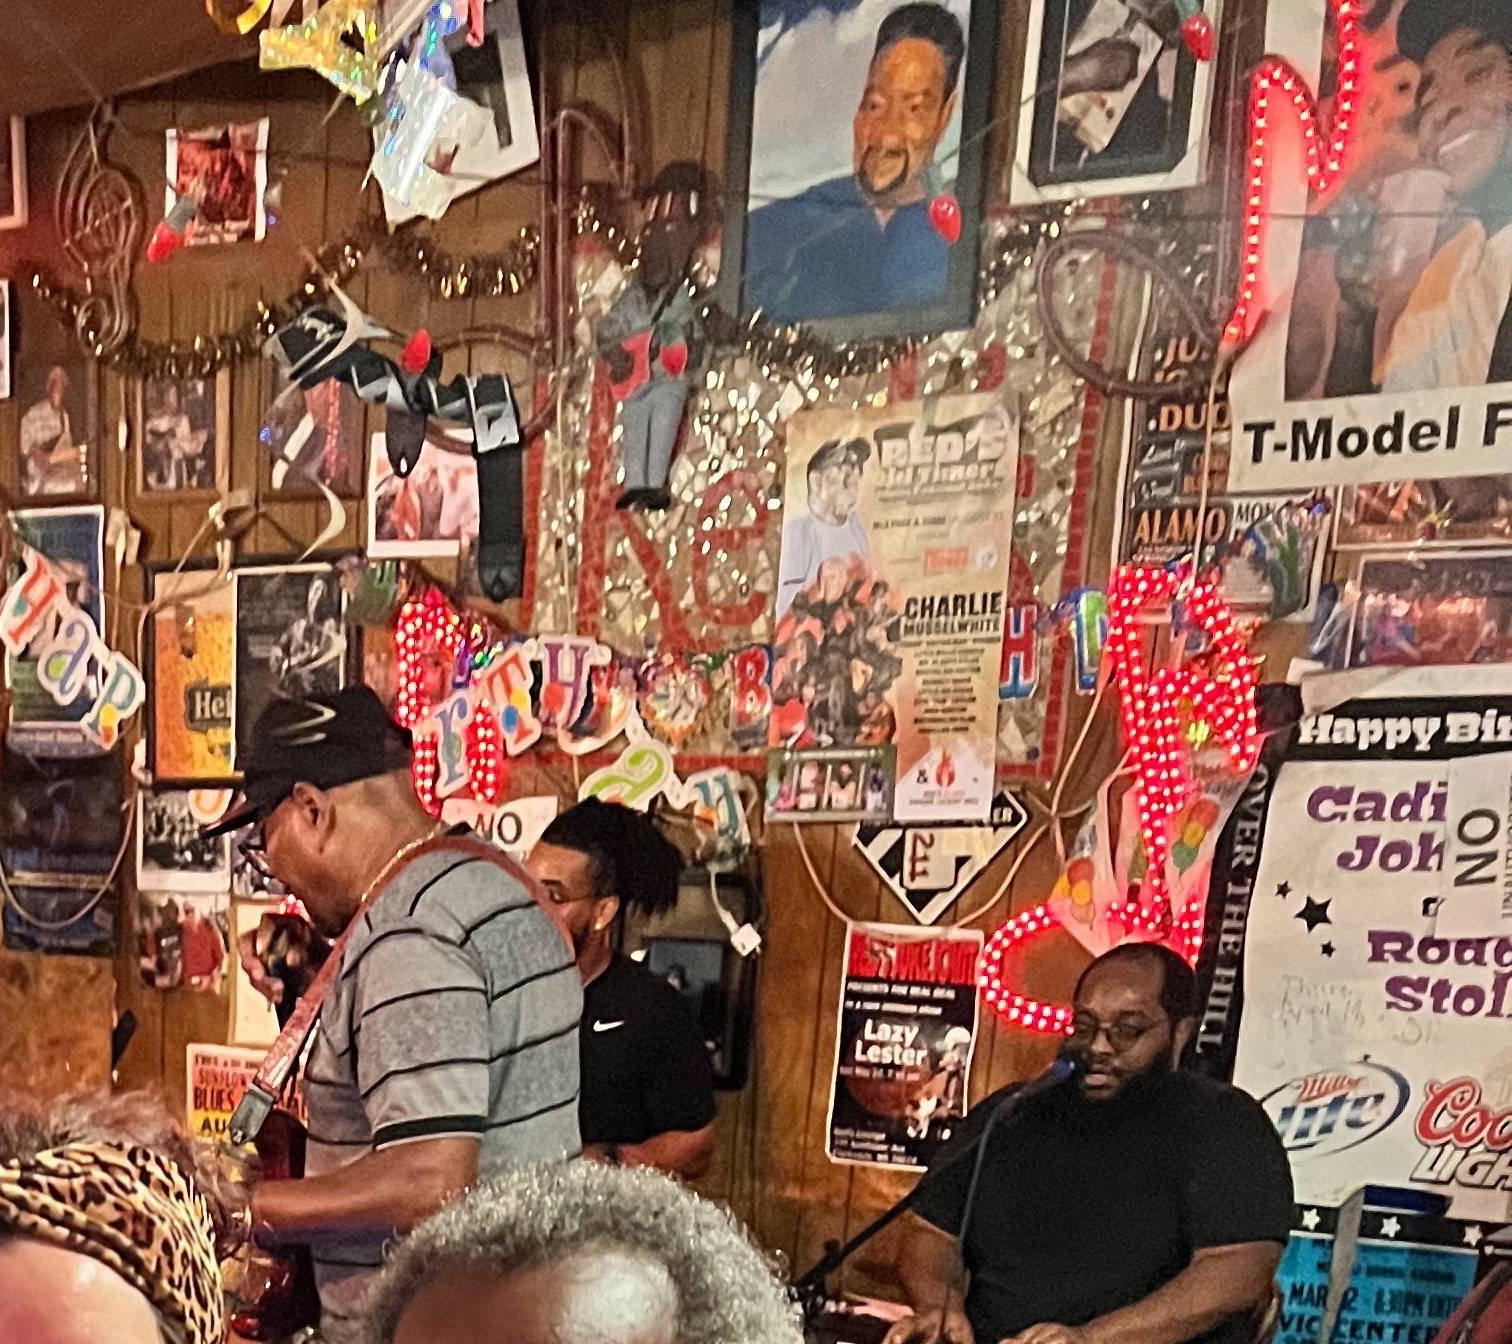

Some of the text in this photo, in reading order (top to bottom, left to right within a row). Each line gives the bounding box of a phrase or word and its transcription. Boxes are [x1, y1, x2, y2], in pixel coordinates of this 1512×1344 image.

[1243, 405, 1460, 464] T-Model
[1133, 507, 1227, 546] ALAMO
[904, 590, 1003, 620] CHARLIE
[1298, 712, 1442, 752] Happy
[1454, 808, 1501, 887] NO
[1219, 879, 1252, 955] THE
[864, 1018, 920, 1047] Lazy
[855, 1039, 928, 1066] Lester
[194, 1085, 235, 1111] BLUES
